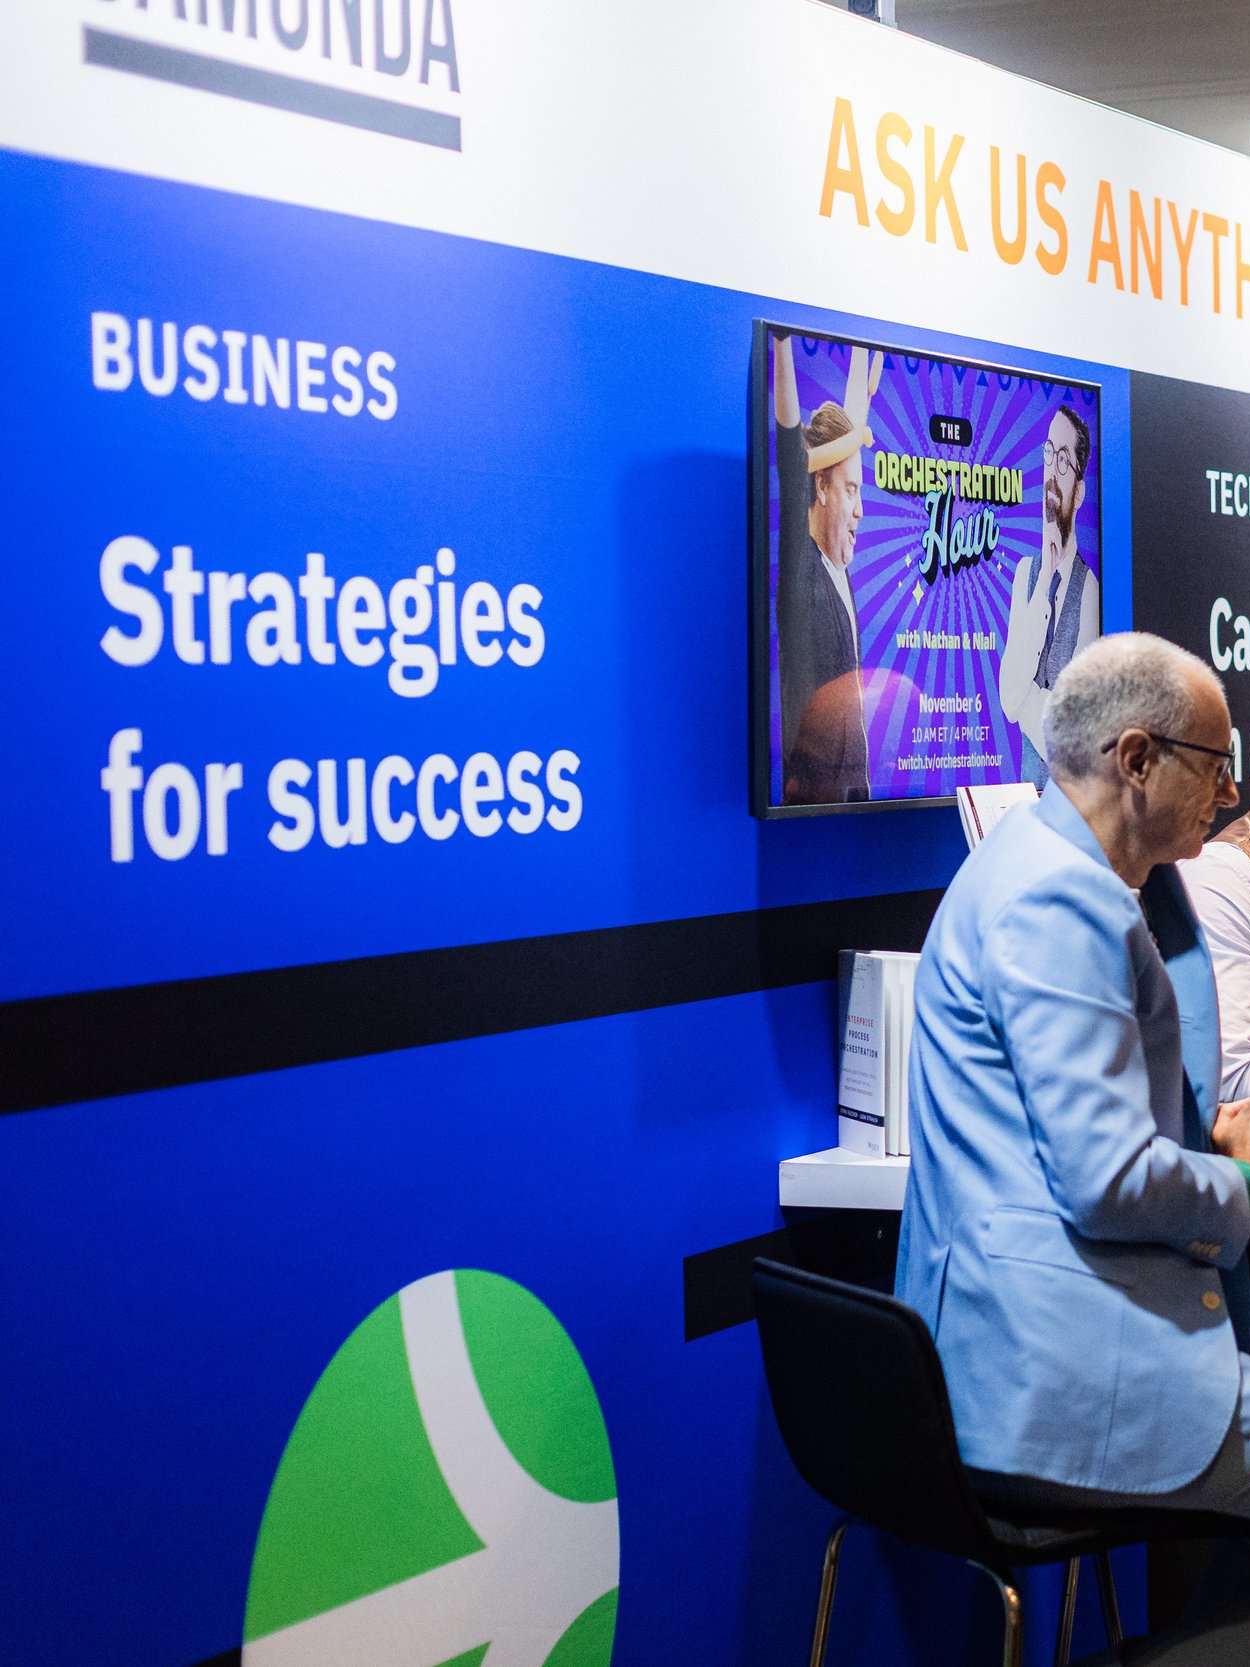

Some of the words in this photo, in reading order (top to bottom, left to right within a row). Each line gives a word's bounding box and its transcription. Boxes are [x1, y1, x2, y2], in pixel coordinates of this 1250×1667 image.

[818, 96, 969, 253] ASK
[989, 144, 1069, 276] US
[91, 311, 398, 421] BUSINESS
[940, 422, 960, 441] THE
[874, 450, 1023, 504] ORCHESTRATION
[918, 486, 1000, 574] Hour
[99, 535, 546, 699] Strategies
[896, 629, 921, 649] with
[923, 630, 960, 650] Nathan
[962, 632, 971, 650] &
[973, 631, 996, 650] Niall
[920, 692, 973, 713] November
[975, 693, 982, 713] 6
[912, 727, 922, 743] 10
[924, 727, 937, 742] AM
[938, 727, 948, 743] ET
[954, 727, 960, 741] 4
[961, 726, 974, 741] PM
[975, 726, 990, 741] CET
[897, 751, 1002, 771] twitch.tv/orchestrationhour
[100, 727, 243, 864] for
[267, 748, 583, 853] success
[845, 1014, 874, 1028] ENTERPRISE
[848, 1029, 870, 1042] PROCESS
[840, 1041, 878, 1059] ORCHESTRATION
